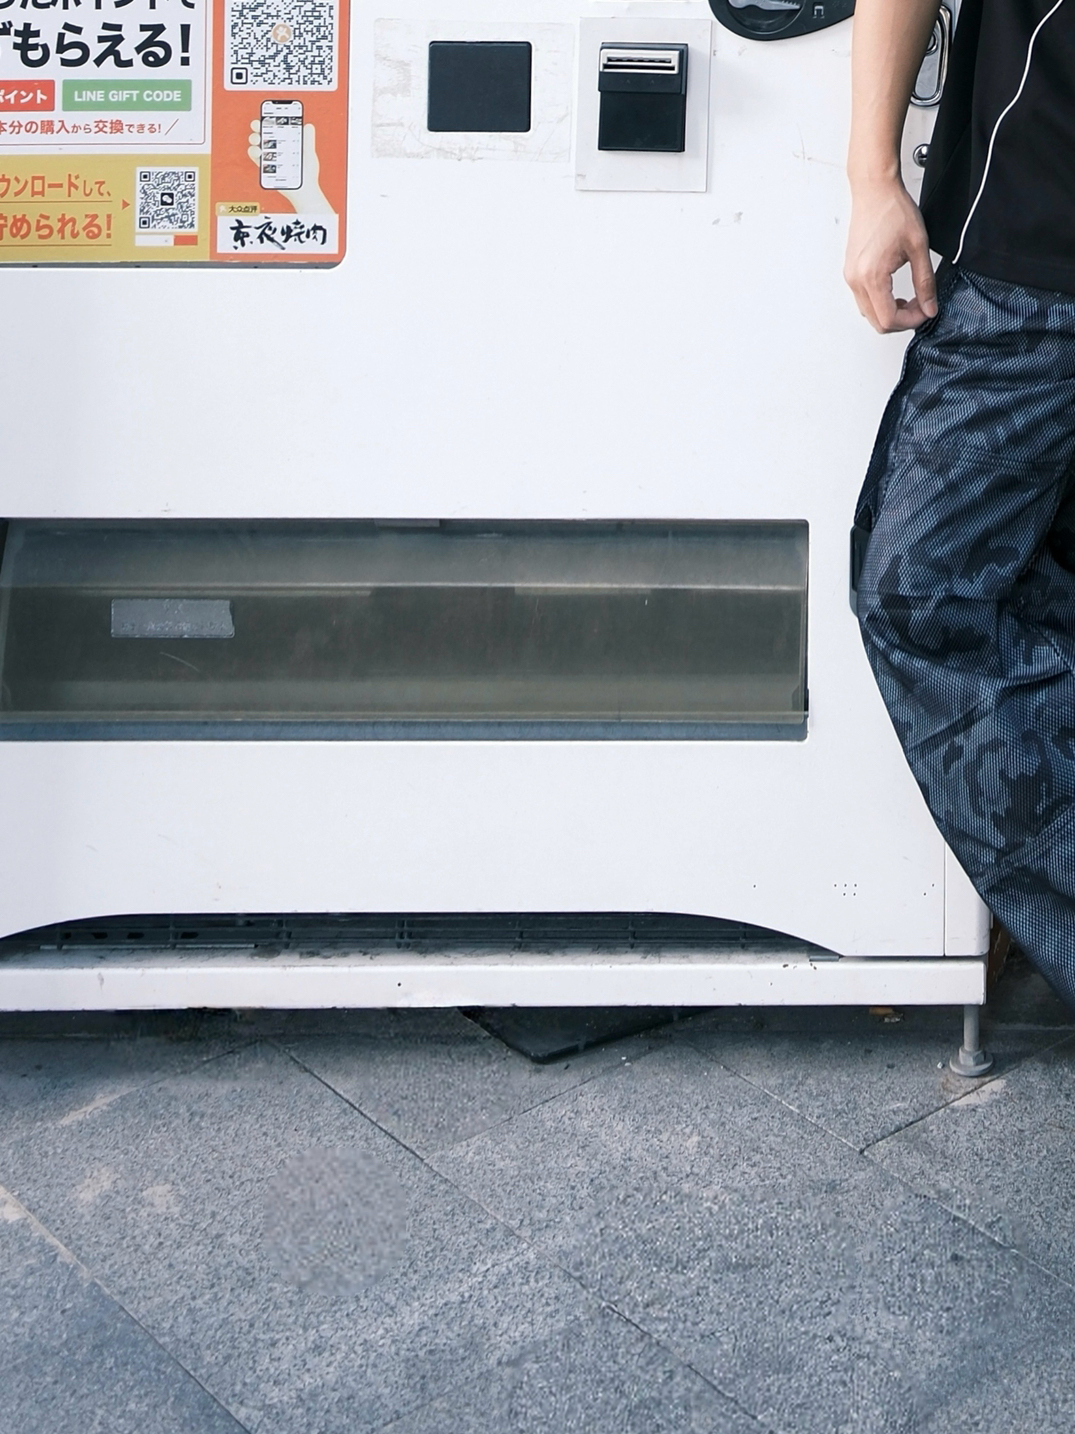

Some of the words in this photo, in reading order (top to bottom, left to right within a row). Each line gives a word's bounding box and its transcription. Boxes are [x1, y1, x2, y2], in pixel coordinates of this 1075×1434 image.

[0, 21, 192, 68] もらえる!
[74, 90, 105, 102] LINE
[109, 90, 140, 102] GIFT
[143, 90, 182, 102] CODE
